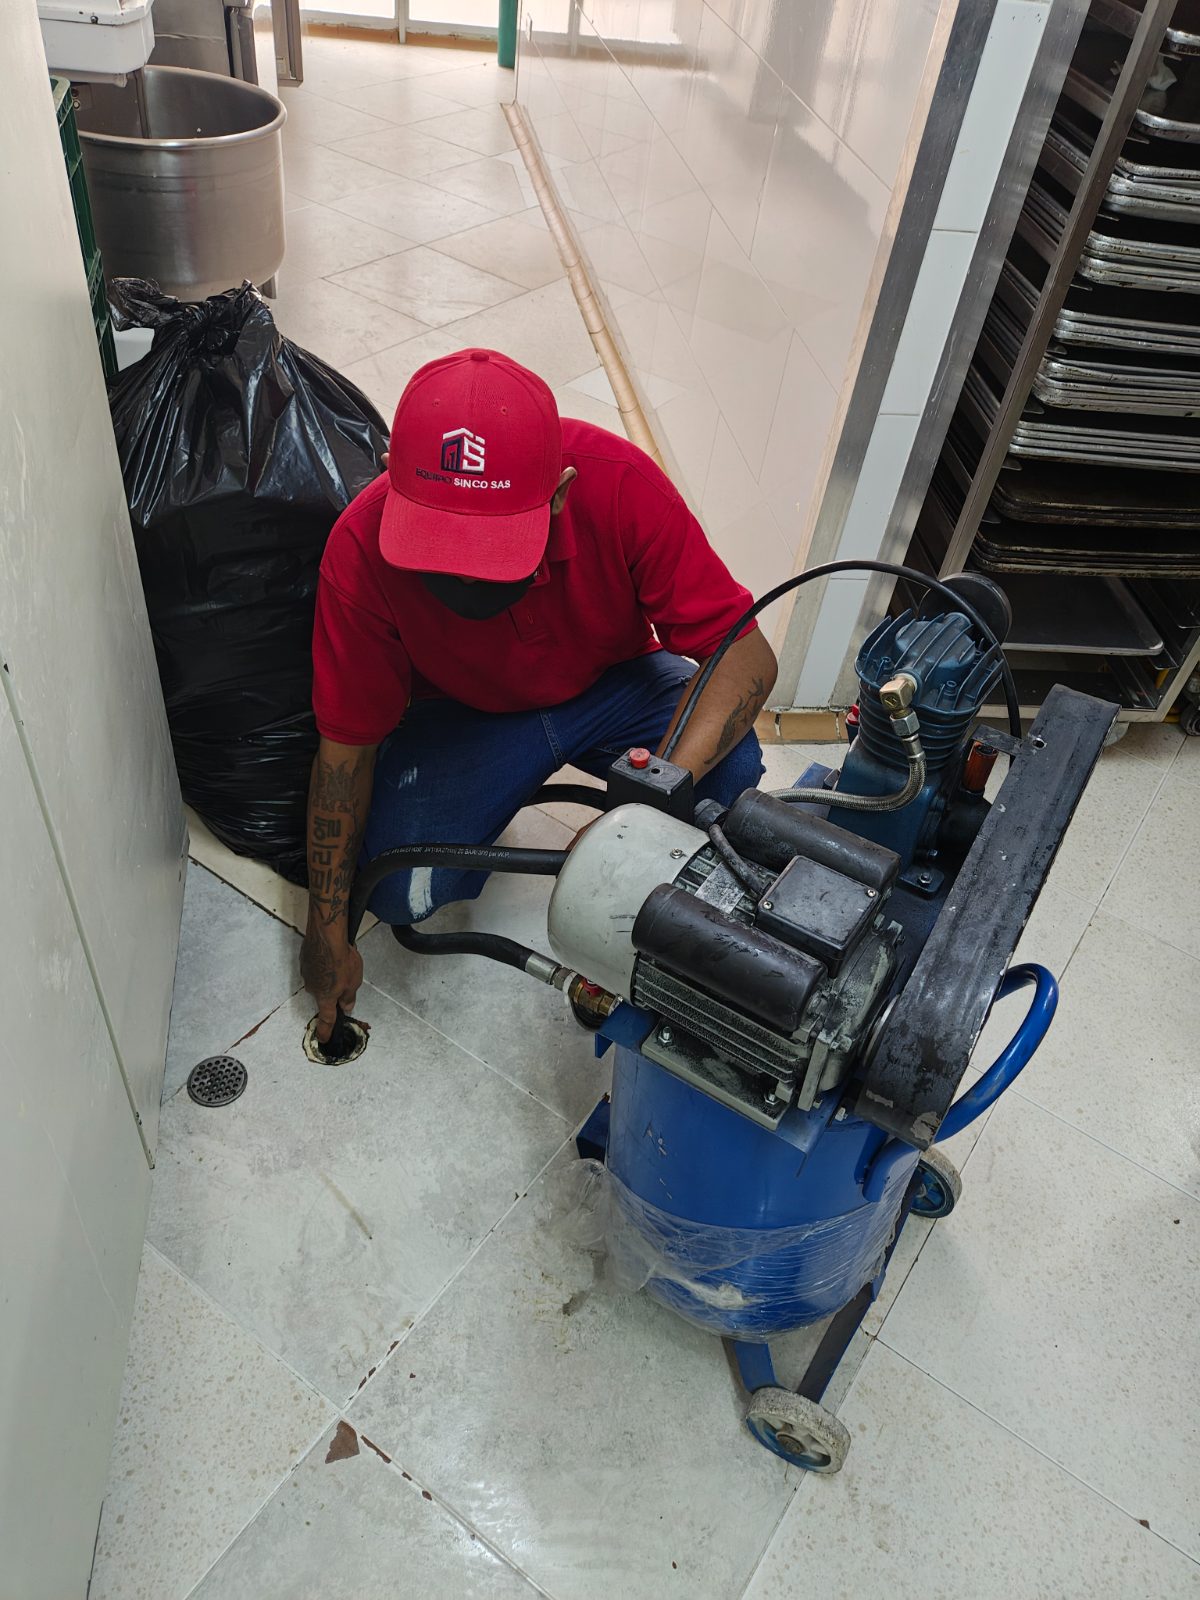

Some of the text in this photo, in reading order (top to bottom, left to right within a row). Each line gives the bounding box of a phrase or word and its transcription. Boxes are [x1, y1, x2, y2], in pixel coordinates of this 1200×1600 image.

[415, 468, 511, 489] EQUIPO SINCO SAS
